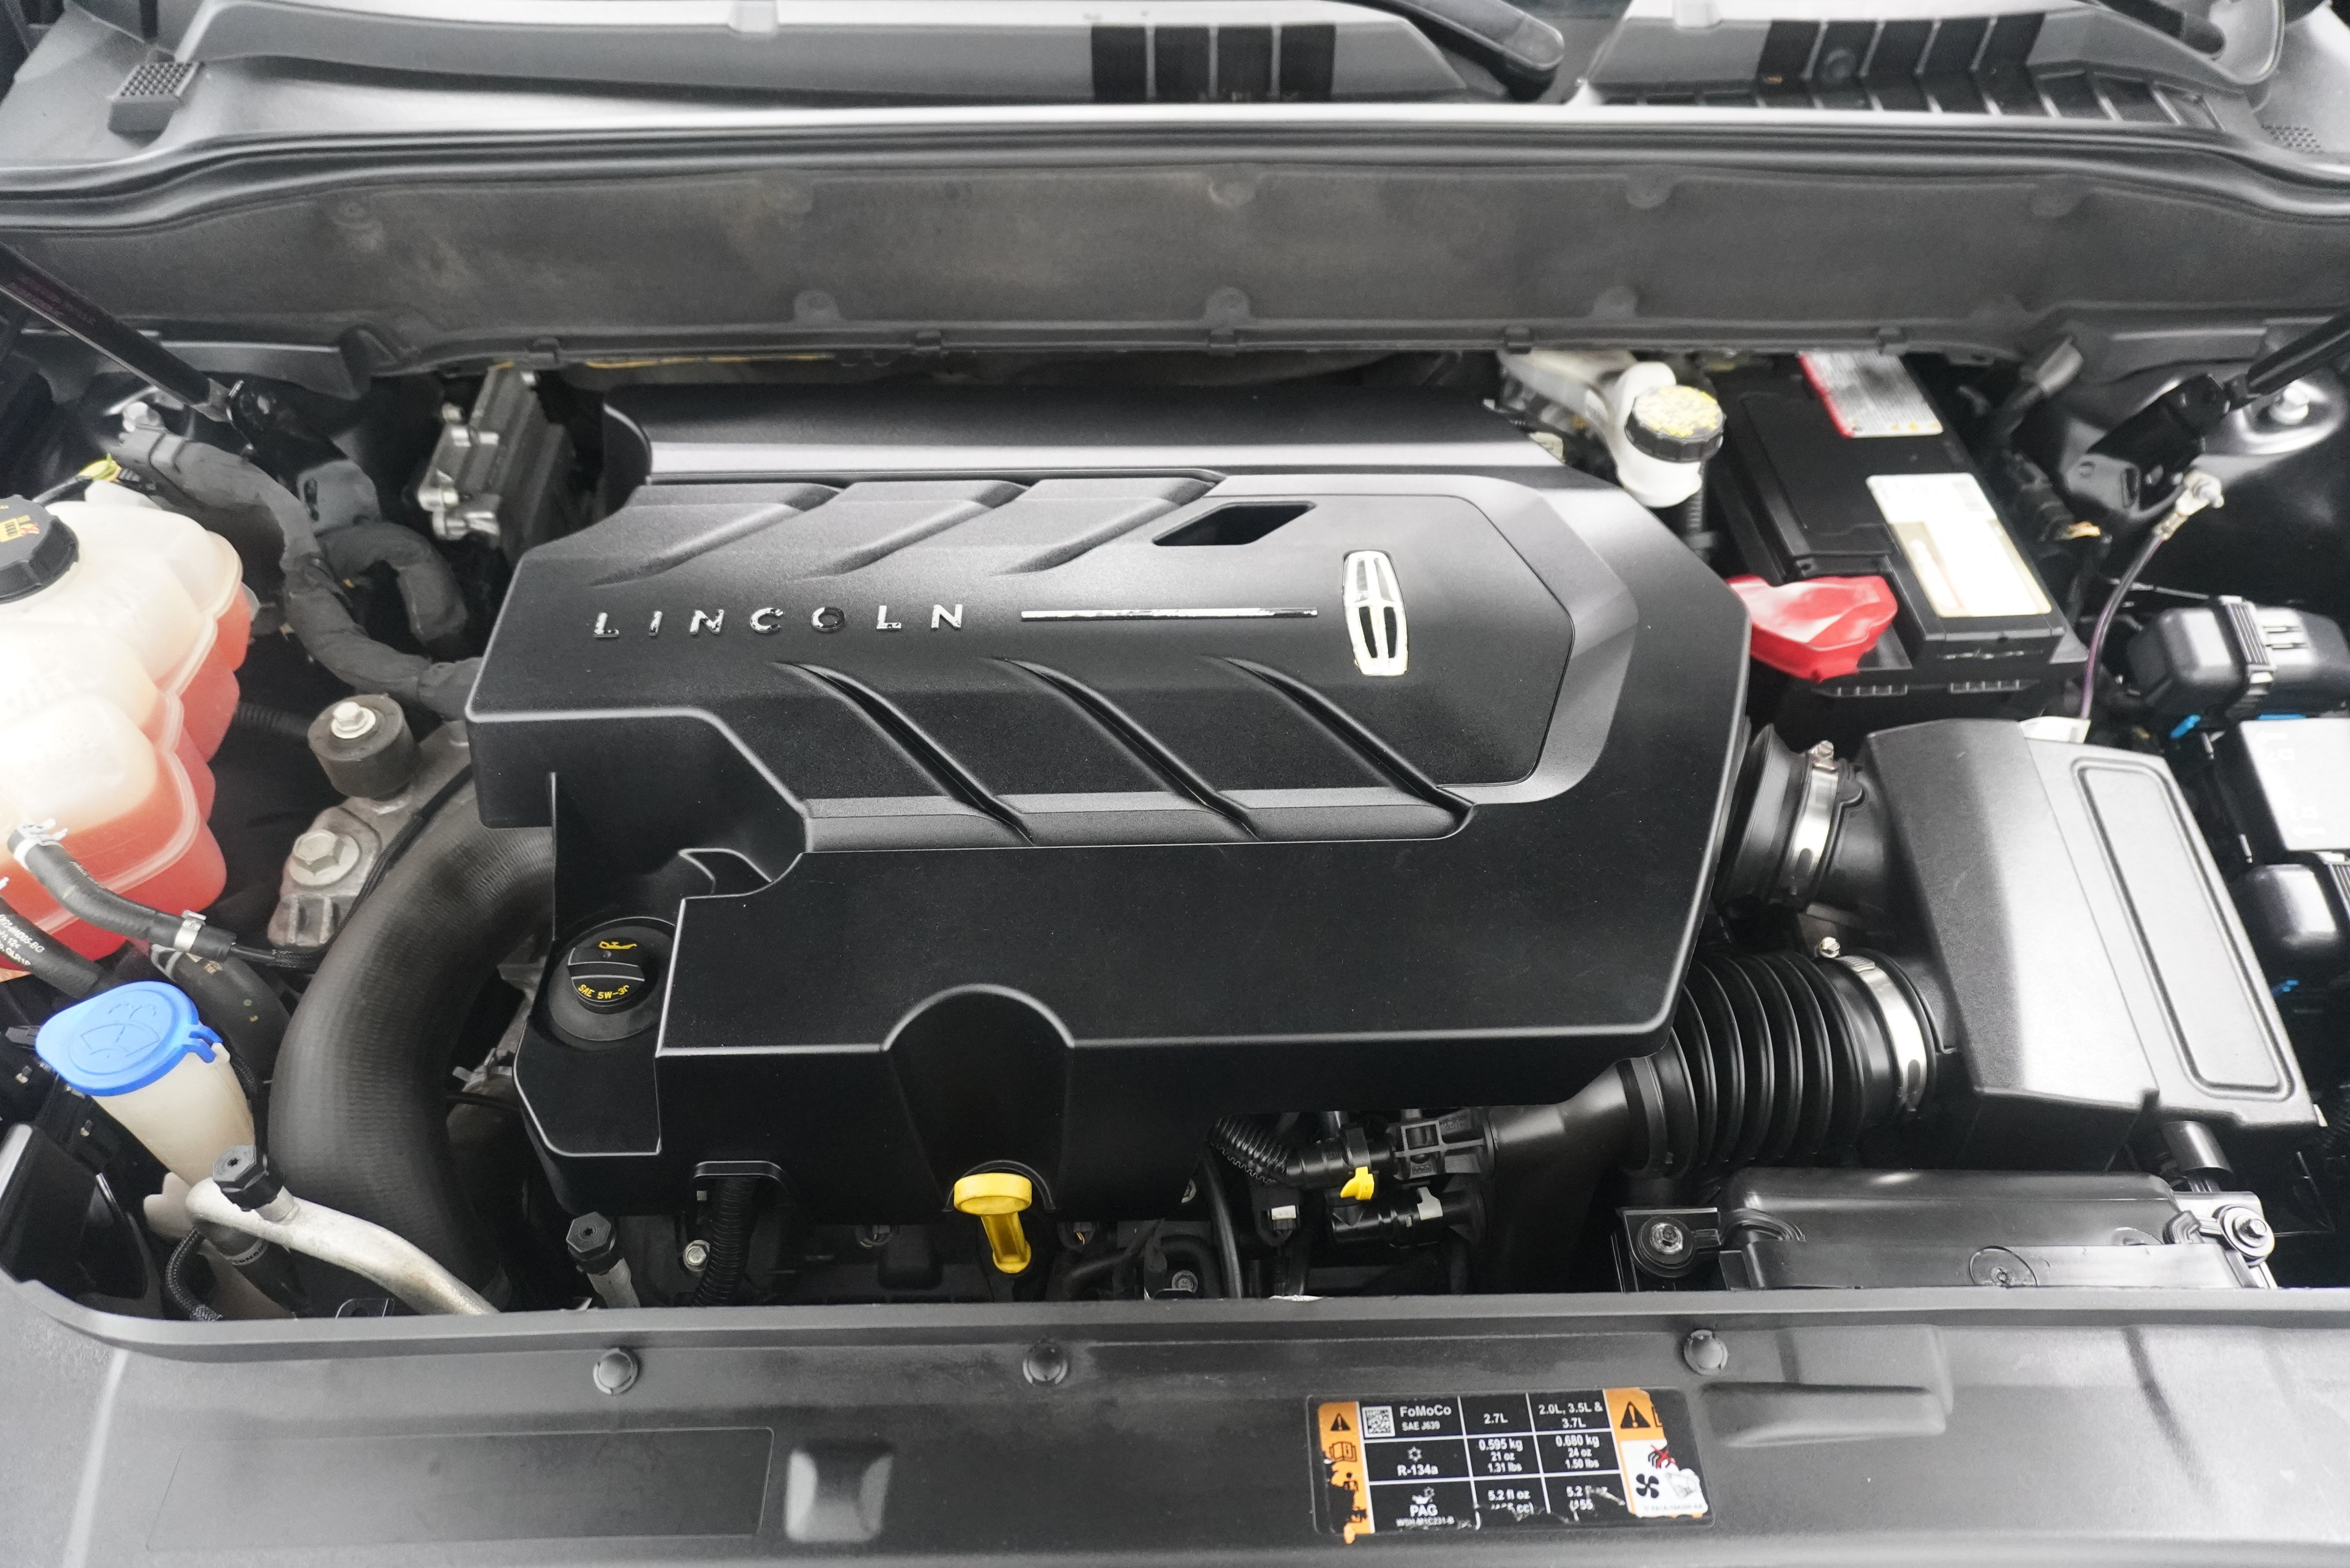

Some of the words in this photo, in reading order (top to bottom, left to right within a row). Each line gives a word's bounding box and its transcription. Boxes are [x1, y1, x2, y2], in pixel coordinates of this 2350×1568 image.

[593, 603, 964, 637] LINCOLN
[578, 984, 595, 998] SAE
[1400, 1404, 1452, 1417] FoMoCo
[1538, 1403, 1566, 1415] 2.0L,
[1568, 1402, 1592, 1413] 3.5L
[1594, 1401, 1603, 1412] &
[1483, 1412, 1508, 1424] 2.7L
[1562, 1417, 1587, 1428] 3.7L
[1401, 1421, 1420, 1431] SAE
[1478, 1438, 1507, 1451] 0.595
[1508, 1437, 1523, 1452] kg
[1555, 1434, 1584, 1447] 0.680
[1585, 1433, 1600, 1448] kg
[1490, 1451, 1501, 1462] 21
[1503, 1452, 1515, 1461] oz
[1568, 1447, 1580, 1458] 24
[1581, 1448, 1592, 1457] oz
[1397, 1463, 1439, 1476] R-134a
[1487, 1462, 1506, 1473] 1.31
[1507, 1462, 1522, 1472] lbs
[1565, 1457, 1584, 1469] 1.50
[1585, 1457, 1600, 1468] lbs
[1488, 1489, 1505, 1501] 5.2
[1516, 1490, 1531, 1500] oz
[1566, 1485, 1583, 1498] 5.2
[1410, 1503, 1438, 1517] PAG
